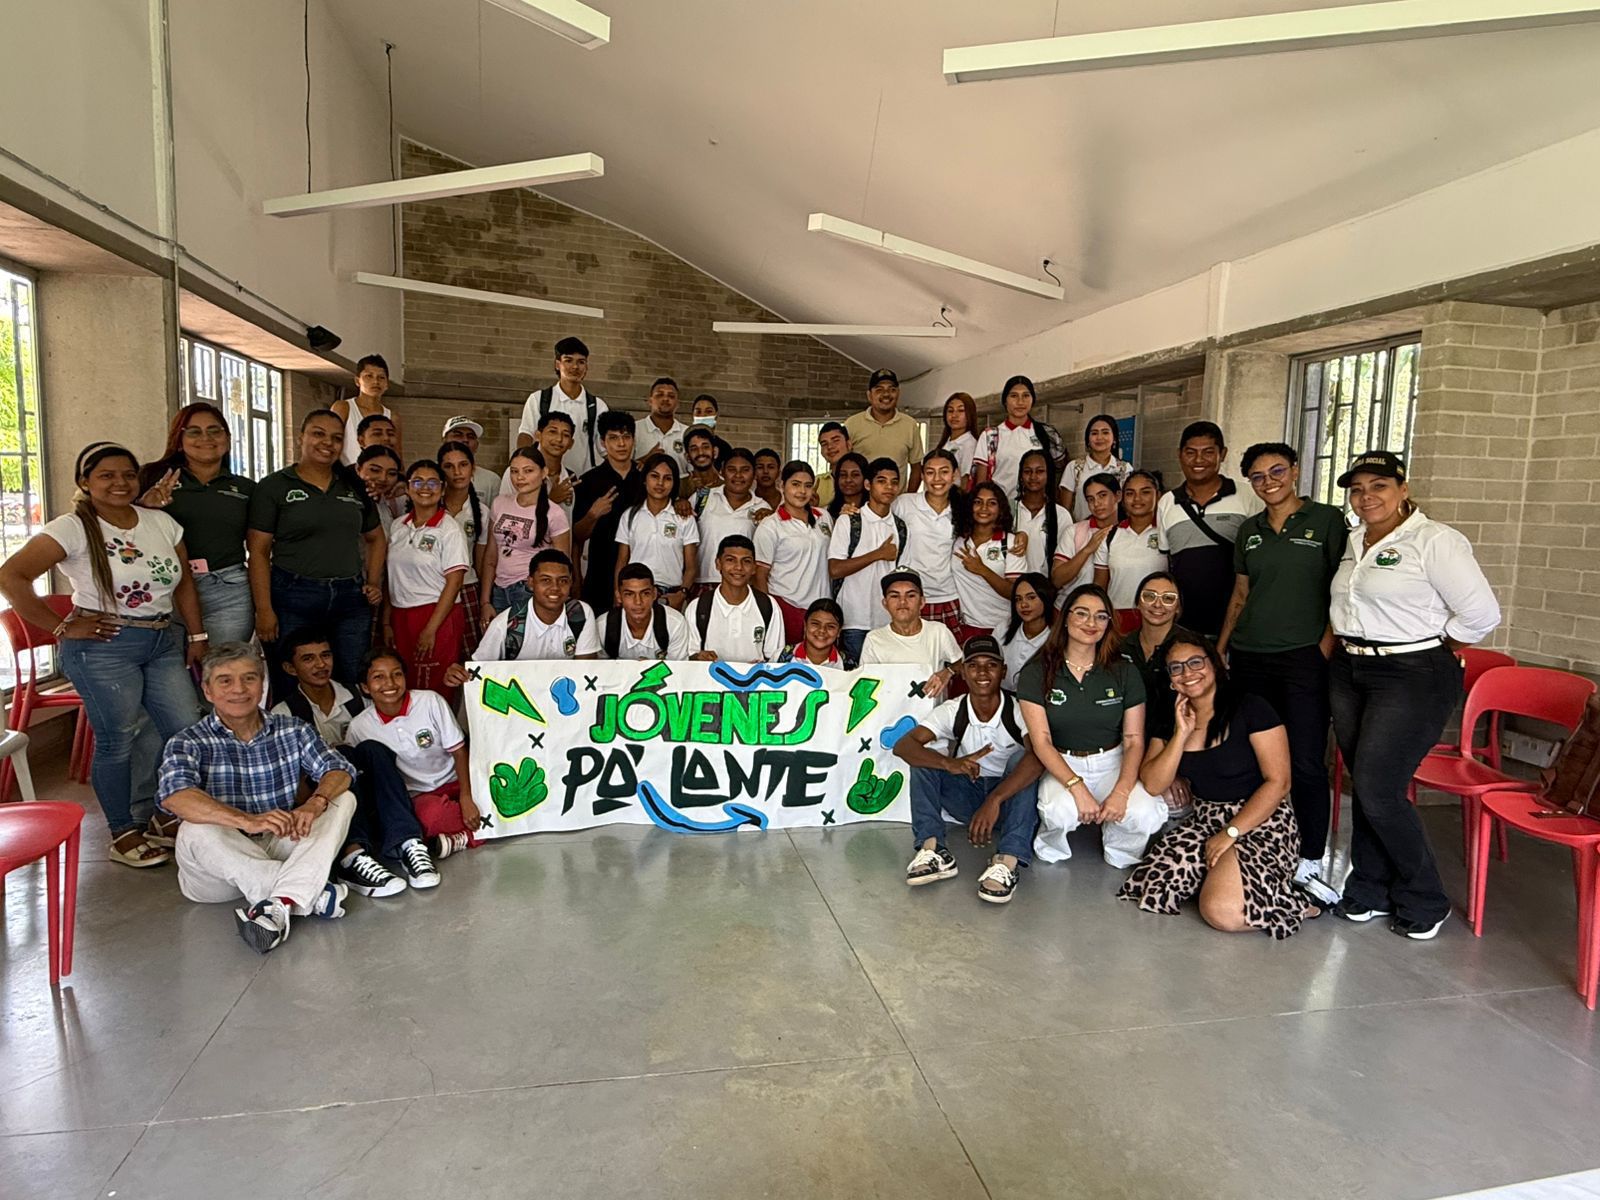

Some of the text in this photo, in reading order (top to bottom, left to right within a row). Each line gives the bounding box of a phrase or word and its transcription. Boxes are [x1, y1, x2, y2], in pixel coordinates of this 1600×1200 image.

[1365, 457, 1386, 465] SOCIAL
[589, 661, 829, 745] JÓVENES
[671, 745, 838, 809] LANTE
